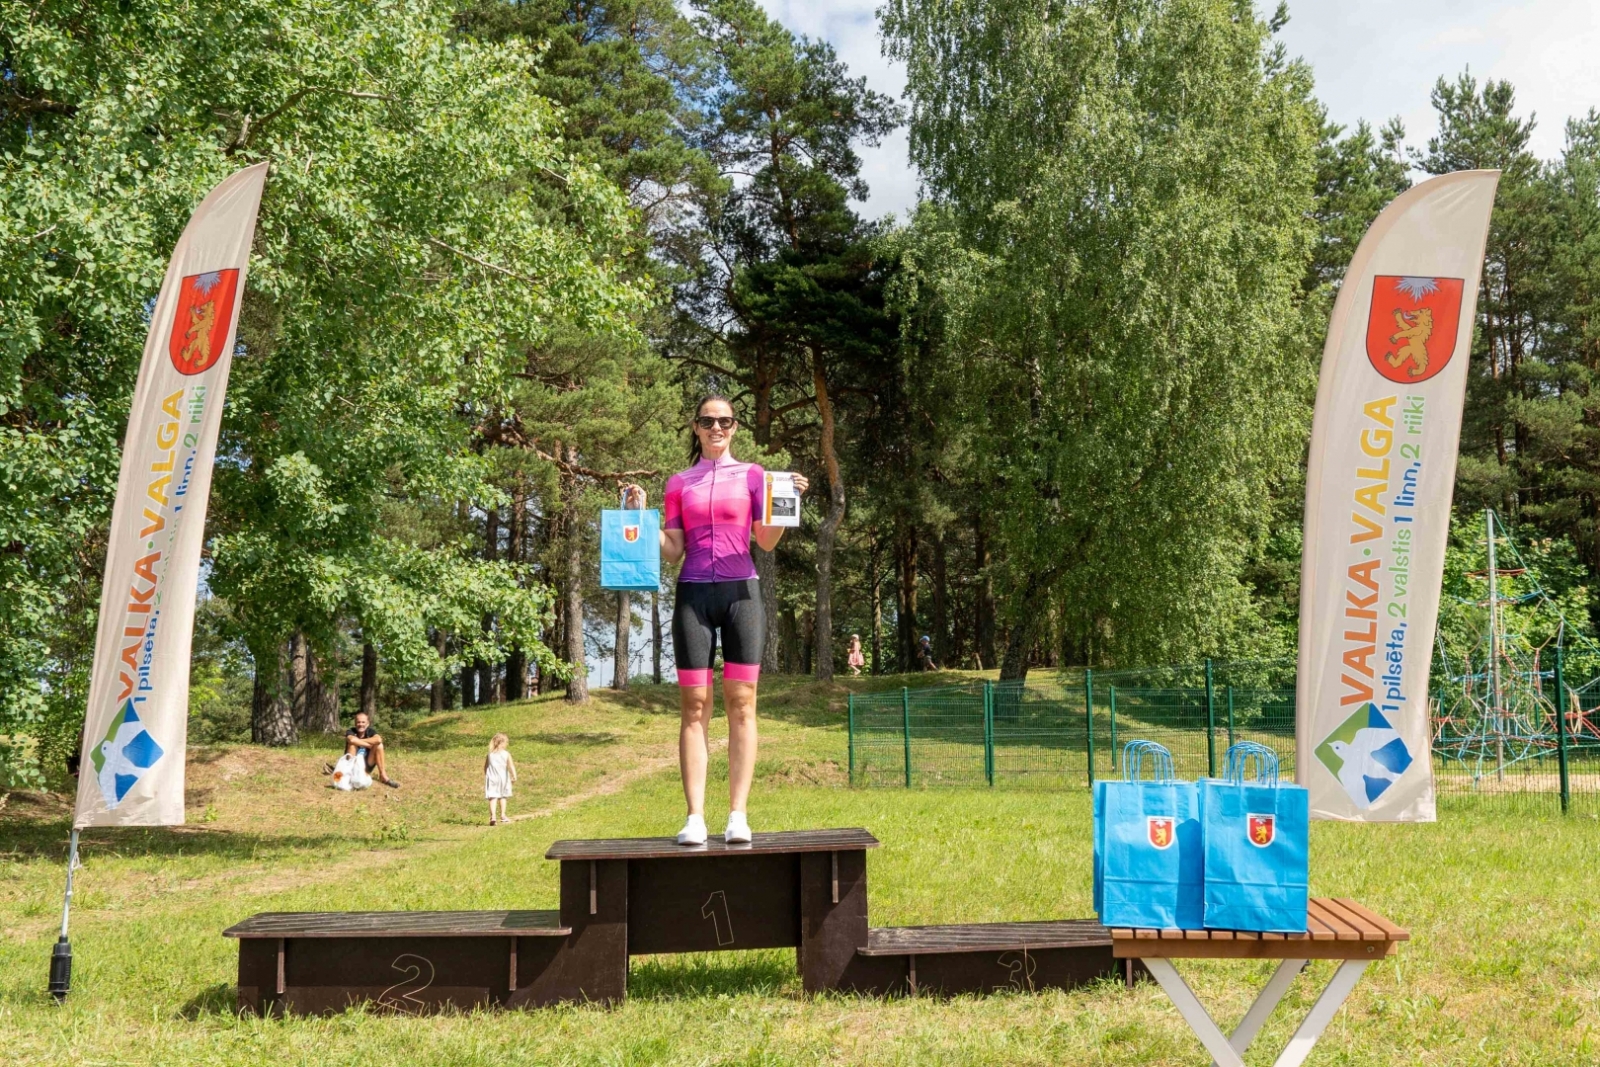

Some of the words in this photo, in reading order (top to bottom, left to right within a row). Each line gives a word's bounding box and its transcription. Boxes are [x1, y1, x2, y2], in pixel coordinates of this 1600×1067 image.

[188, 385, 206, 424] riiki
[1403, 395, 1425, 434] riiki
[183, 432, 199, 449] 2
[1400, 443, 1421, 459] 2
[1393, 462, 1421, 507] linn,
[1388, 528, 1412, 598] valstis
[1387, 602, 1407, 618] 2
[1381, 622, 1408, 701] pilsēta,
[701, 890, 734, 947] 1
[377, 953, 435, 1016] 2
